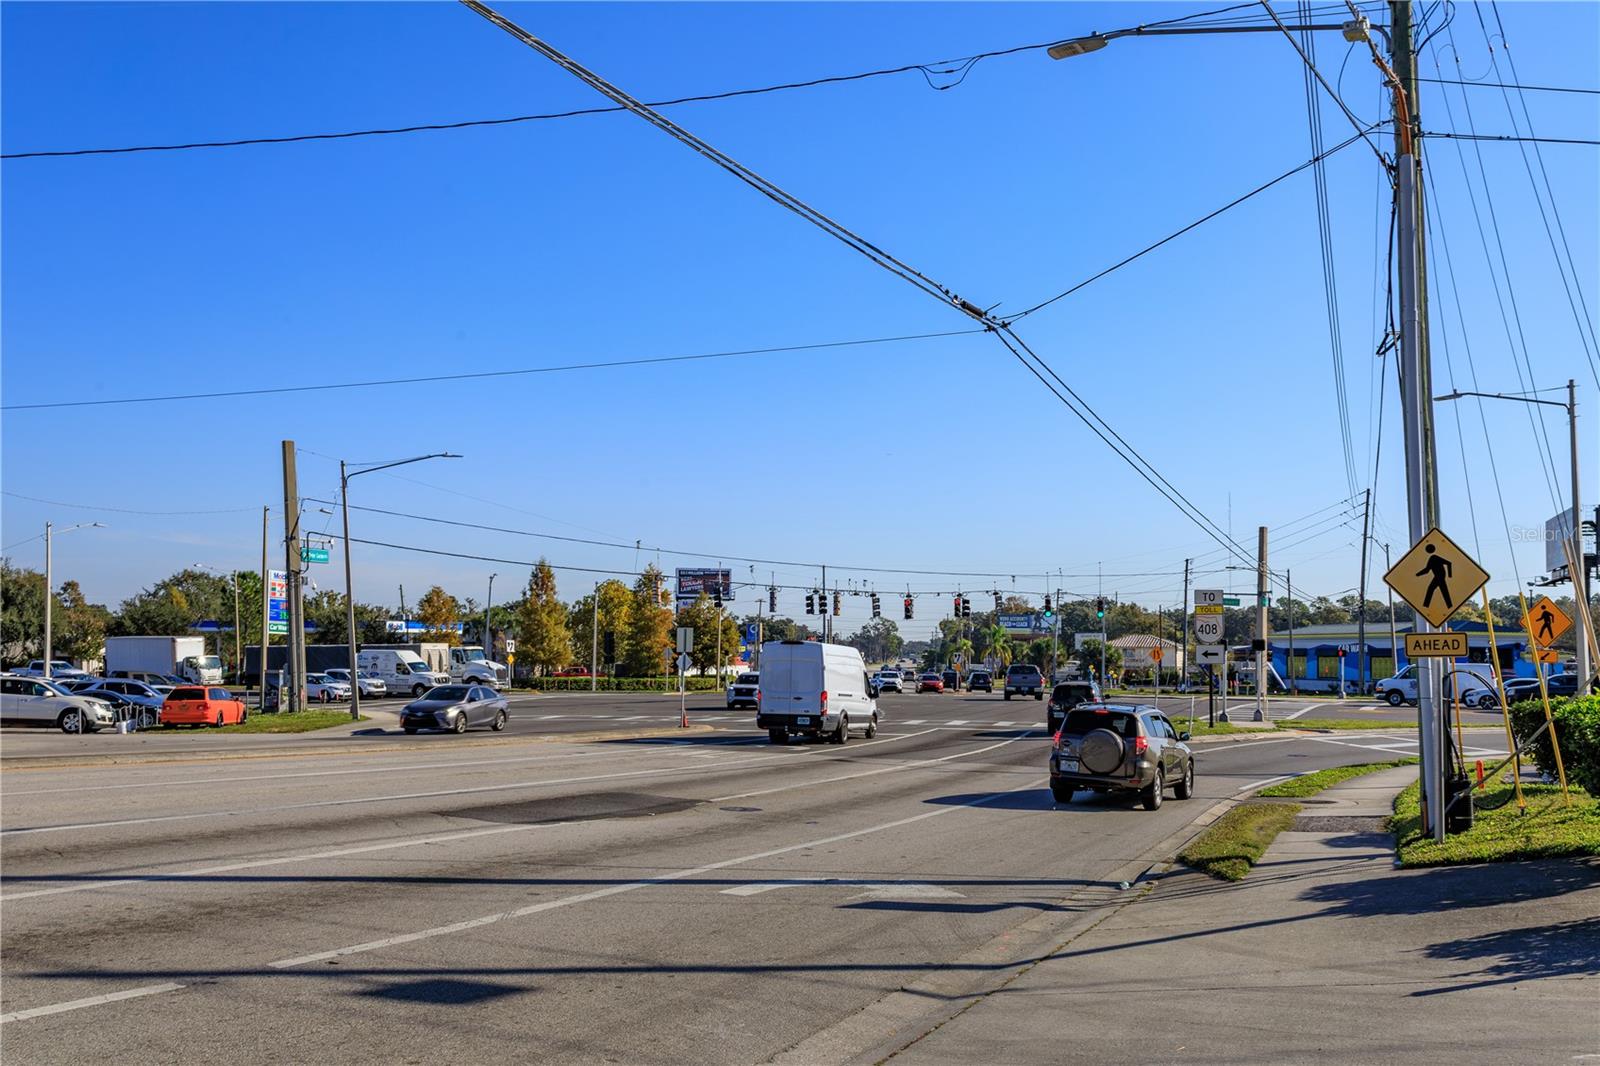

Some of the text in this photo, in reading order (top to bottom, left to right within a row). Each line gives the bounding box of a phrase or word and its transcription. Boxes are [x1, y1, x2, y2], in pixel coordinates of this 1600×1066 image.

[1203, 592, 1216, 602] TO
[1198, 623, 1218, 635] 408
[1350, 644, 1368, 653] WAH
[1413, 639, 1460, 651] AHEAD
